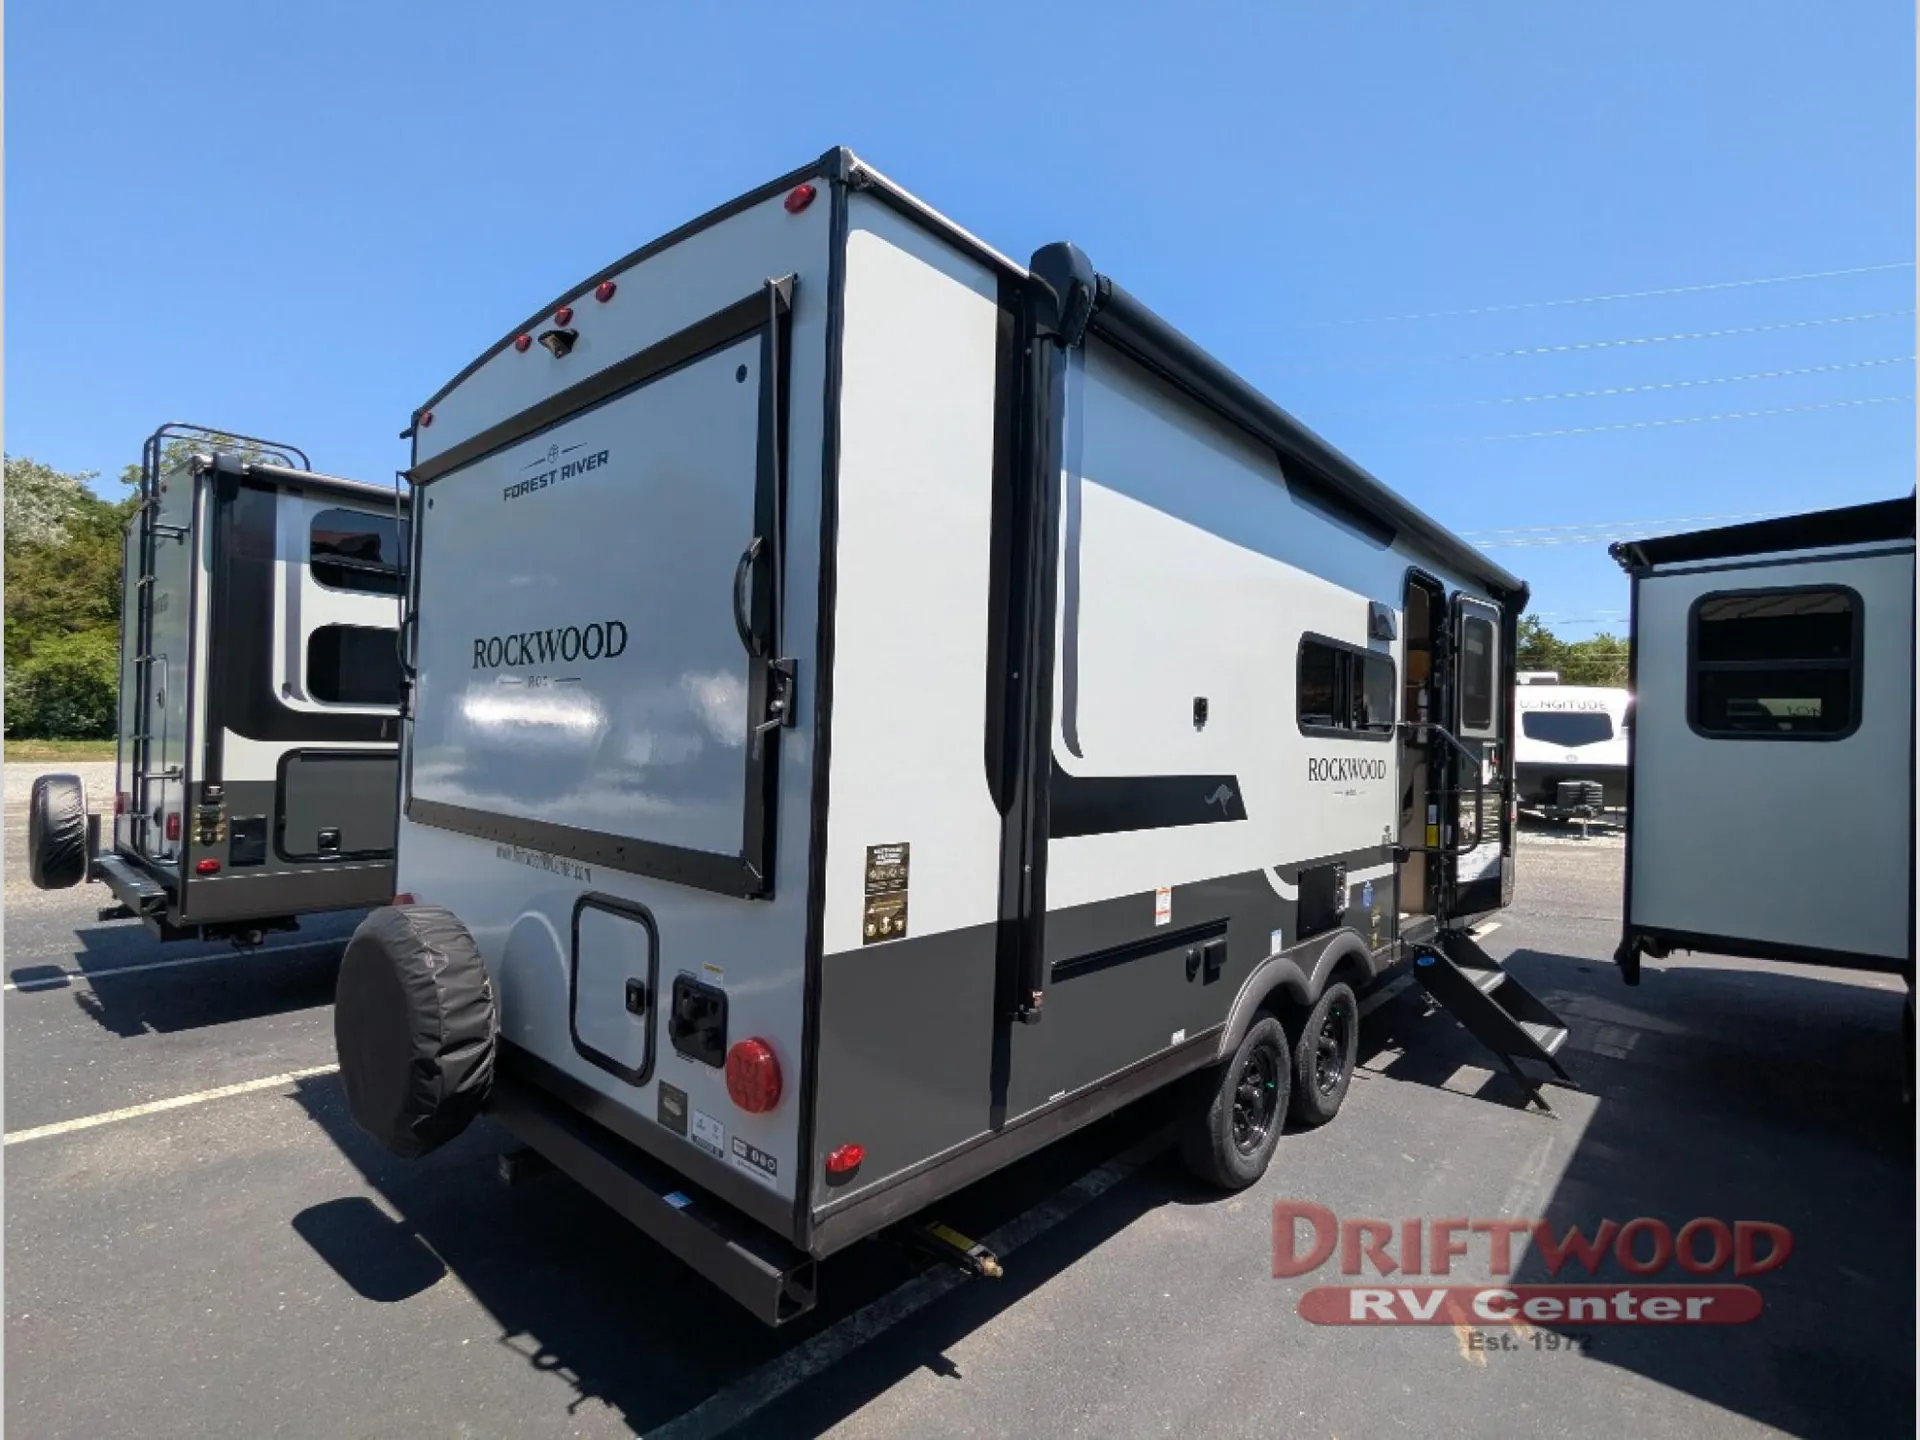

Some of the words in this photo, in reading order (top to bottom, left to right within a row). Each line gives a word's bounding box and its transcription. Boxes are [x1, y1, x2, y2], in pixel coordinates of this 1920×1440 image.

[503, 469, 558, 502] FOREST
[561, 449, 610, 481] RIVER
[472, 620, 628, 669] ROCKWOOD
[1308, 757, 1387, 781] ROCKWOOD
